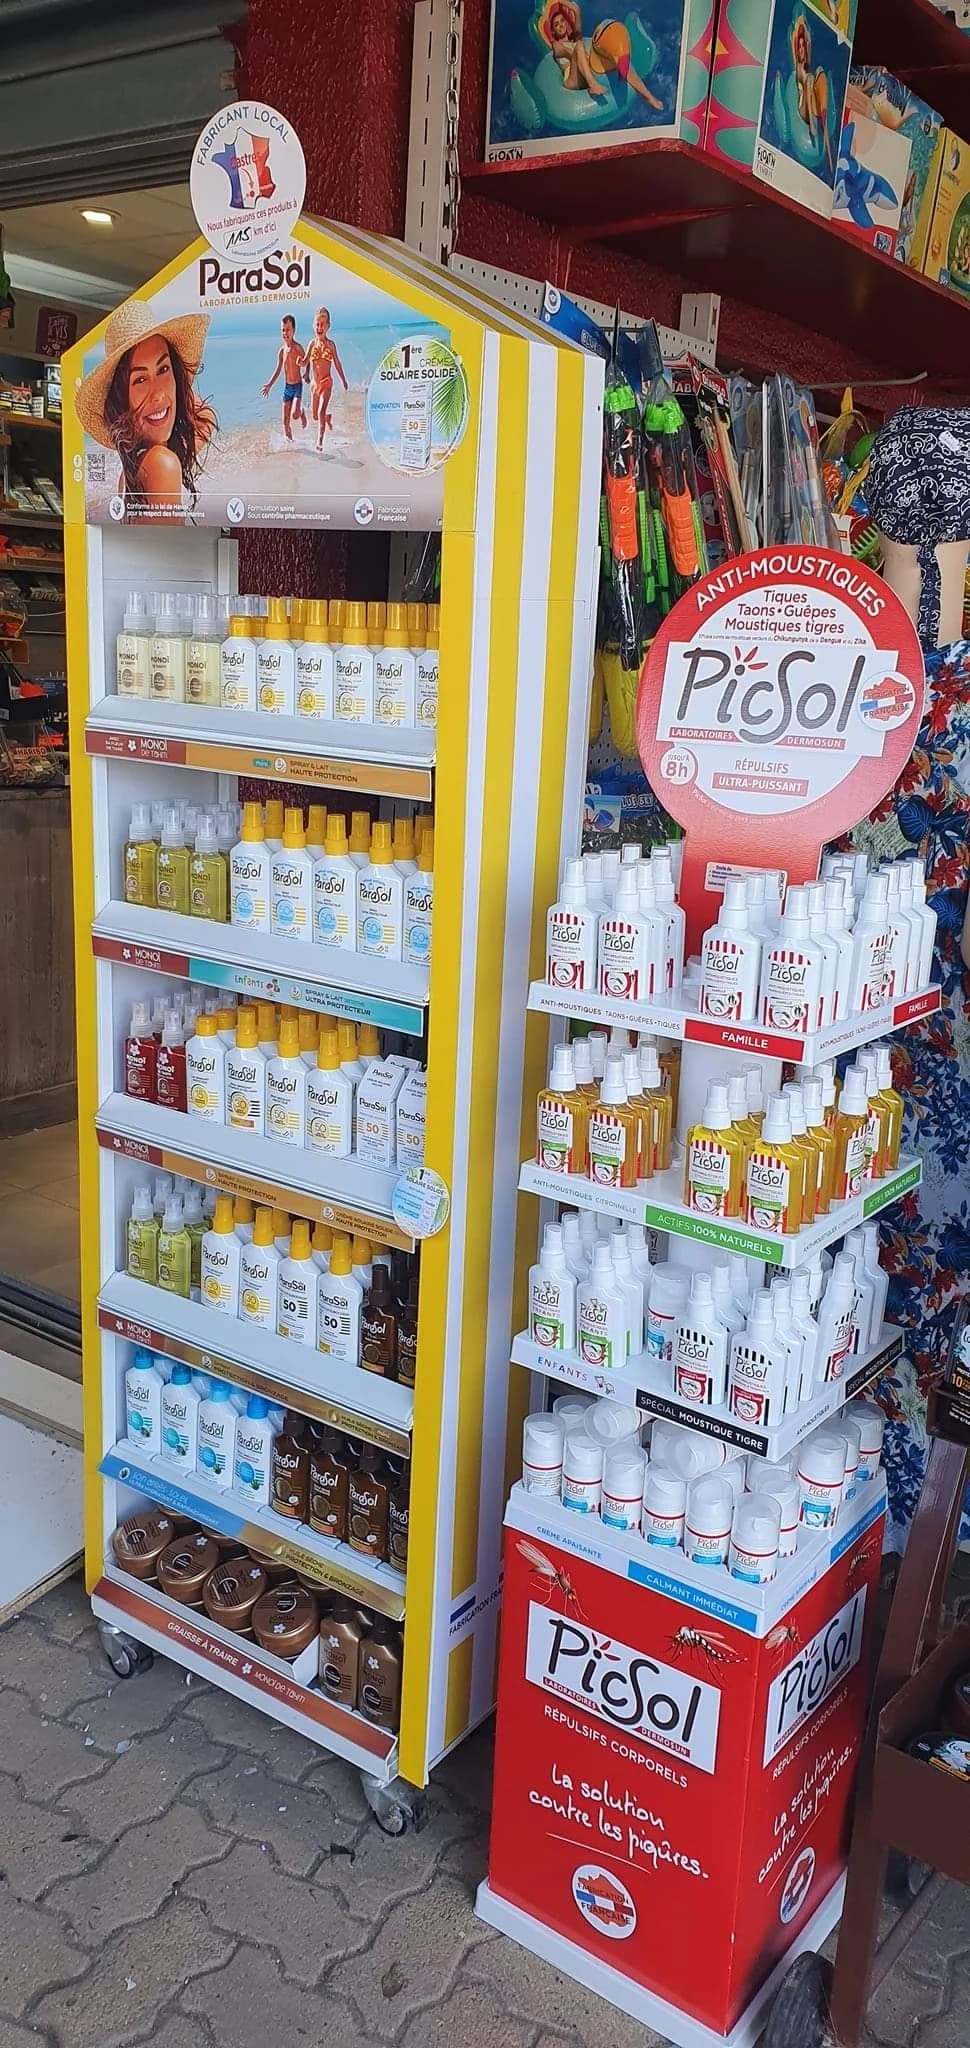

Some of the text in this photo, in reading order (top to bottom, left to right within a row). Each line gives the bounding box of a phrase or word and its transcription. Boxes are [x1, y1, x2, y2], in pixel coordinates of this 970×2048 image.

[197, 107, 290, 166] FABRICANT LOCAL
[207, 201, 294, 232] Nous fabriquons ces produits
[254, 228, 264, 237] km
[200, 250, 310, 296] ParaSol
[200, 291, 310, 307] LABORATOIRES DERMOSUN
[381, 370, 419, 381] SOLAIRE
[408, 421, 419, 431] 50
[377, 513, 407, 522] Française
[696, 555, 886, 617] ANTI-MOUSTIQUES
[764, 590, 808, 604] Tiques
[725, 617, 845, 635] Moustiques tigres
[222, 651, 245, 667] ParaSol
[258, 654, 281, 669] ParaSol
[297, 657, 322, 673] ParaSol
[336, 660, 362, 677] ParaSol
[376, 662, 403, 680] ParaSol
[677, 647, 866, 744] PicSol
[671, 727, 842, 748] LABORATOIRES DERMOSUN
[290, 768, 358, 783] HAUTE PROTECTION
[666, 761, 689, 778] 8h
[735, 757, 789, 774] RÉPULSIFS
[718, 775, 803, 793] ULTRA-PUISSANT
[232, 859, 261, 879] ParaSol
[272, 866, 302, 887] ParaSol
[315, 873, 345, 894] ParaSol
[360, 882, 392, 904] ParaSol
[552, 924, 581, 942] PicSol
[604, 933, 635, 951] PicSol
[707, 952, 739, 972] PicSol
[770, 963, 806, 983] PicSol
[305, 989, 324, 998] SPRAY
[331, 994, 343, 1002] LAIT
[305, 996, 371, 1016] ULTRA PROTECTEUR
[541, 998, 602, 1015] ANTI-MOUSTIQUES
[908, 1000, 928, 1014] FAMILLE
[721, 1031, 769, 1049] FAMILLE
[187, 1054, 216, 1073] ParaSol
[228, 1062, 257, 1082] ParaSol
[268, 1072, 297, 1093] ParaSol
[373, 1068, 394, 1080] ParaSol
[308, 1084, 338, 1106] ParaSol
[359, 1097, 387, 1113] ParaSol
[274, 1109, 286, 1120] 50
[541, 1110, 569, 1129] PicSol
[314, 1122, 327, 1134] 50
[366, 1123, 380, 1135] 50
[592, 1123, 622, 1143] PicSol
[406, 1133, 420, 1146] 50
[692, 1150, 726, 1171] PicSol
[751, 1164, 785, 1187] PicSol
[533, 1178, 637, 1215] ANTI-MOUSTIQUES CITRONNELLE
[335, 1215, 388, 1238] HAUTE PROTECTION
[658, 1214, 773, 1256] ACTIFS 100% NATURELS
[203, 1247, 229, 1266] ParaSol
[241, 1257, 268, 1279] ParaSol
[279, 1274, 306, 1292] ParaSol
[319, 1288, 348, 1307] ParaSol
[533, 1285, 560, 1305] PicSol
[283, 1299, 296, 1313] 50
[580, 1301, 607, 1322] PicSol
[323, 1315, 338, 1329] 50
[361, 1316, 386, 1334] ParaSol
[678, 1338, 709, 1361] PicSol
[537, 1356, 588, 1382] ENFANTS
[735, 1356, 768, 1378] PicSol
[127, 1380, 149, 1400] ParaSol
[163, 1398, 187, 1418] ParaSol
[200, 1415, 225, 1436] ParaSol
[641, 1396, 764, 1451] SPÉCIAL MOUSTIQUE TIGRE
[237, 1429, 263, 1451] ParaSol
[273, 1446, 299, 1469] ParaSol
[311, 1463, 339, 1488] ParaSol
[350, 1483, 378, 1507] ParaSol
[567, 1482, 585, 1494] PicSol
[808, 1485, 831, 1497] PicSol
[605, 1499, 625, 1513] PicSol
[653, 1517, 675, 1531] PicSol
[562, 1536, 602, 1560] APAISANTE
[697, 1538, 720, 1550] PicSol
[736, 1551, 759, 1567] PicSol
[286, 1551, 323, 1579] PROTECTION
[329, 1573, 365, 1596] BRONZAGE
[646, 1573, 738, 1620] CALMANT IMMÉDIAT
[167, 1621, 201, 1646] GRAISSE
[208, 1644, 239, 1667] TRAIRE
[778, 1598, 858, 1734] PicSol
[548, 1619, 702, 1743] PicSol
[544, 1678, 688, 1756] LABORATOIRES DERMOSUN
[544, 1704, 688, 1788] RÉPULSIFS CORPORELS
[792, 1748, 835, 1812] solution
[580, 1779, 664, 1831] solution
[758, 1745, 854, 1884] contre les piqûres.
[529, 1790, 709, 1879] contre les piqûres.
